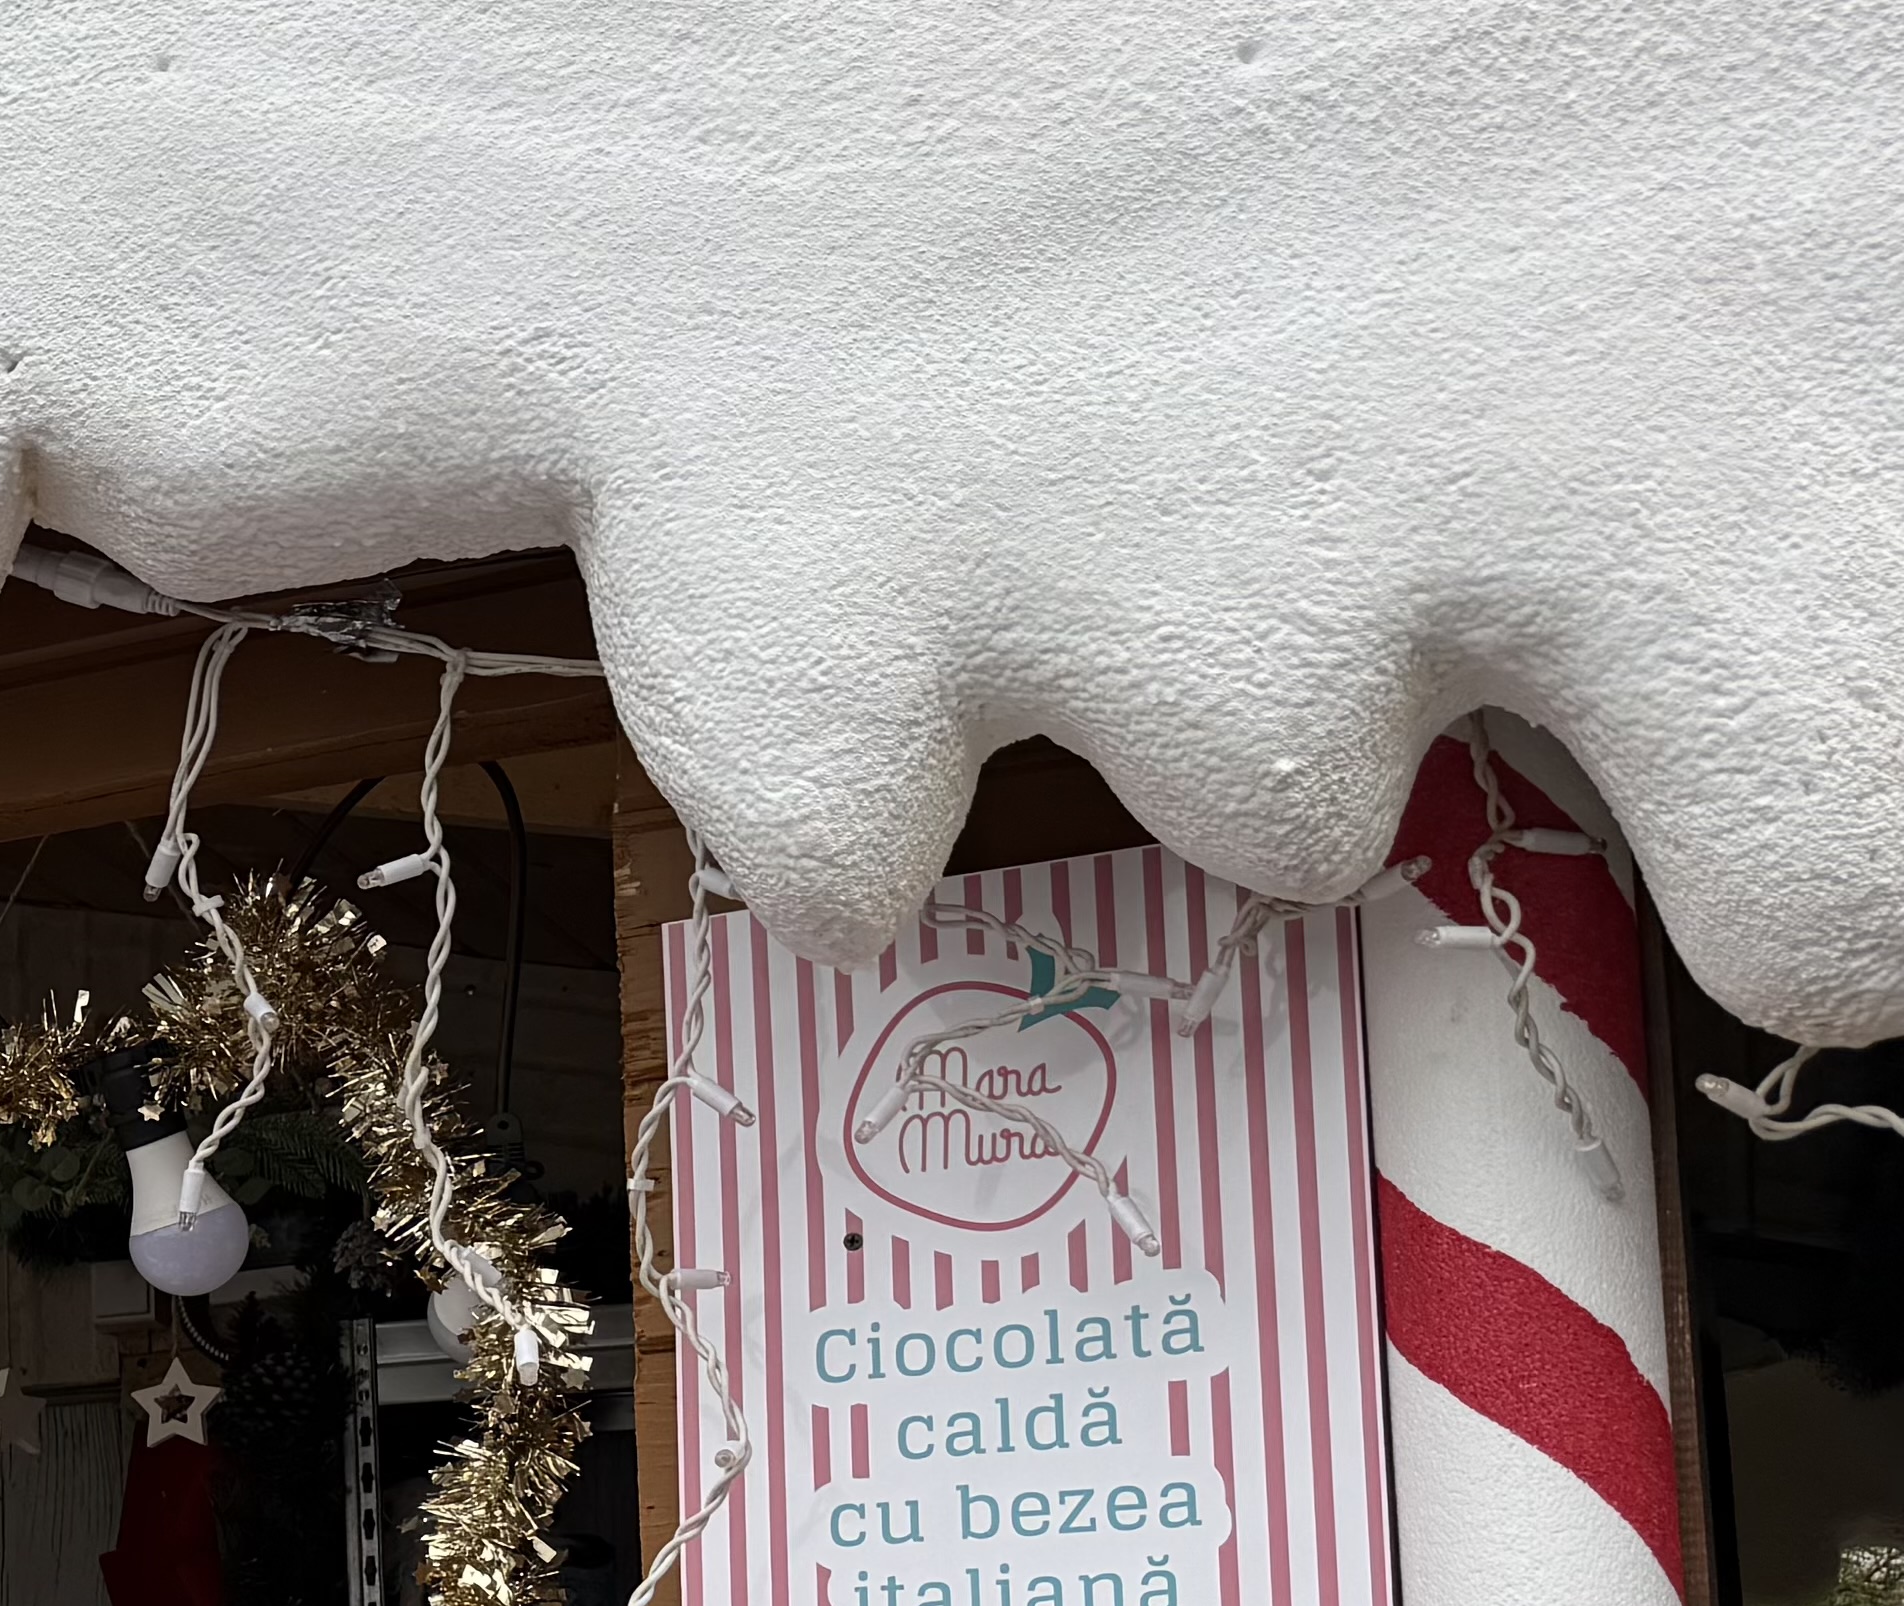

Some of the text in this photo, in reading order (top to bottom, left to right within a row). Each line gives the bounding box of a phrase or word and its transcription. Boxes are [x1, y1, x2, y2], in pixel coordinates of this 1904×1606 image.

[814, 1292, 1205, 1384] Ciocolată
[895, 1385, 1123, 1460] caldă
[829, 1479, 1203, 1548] cu bezea
